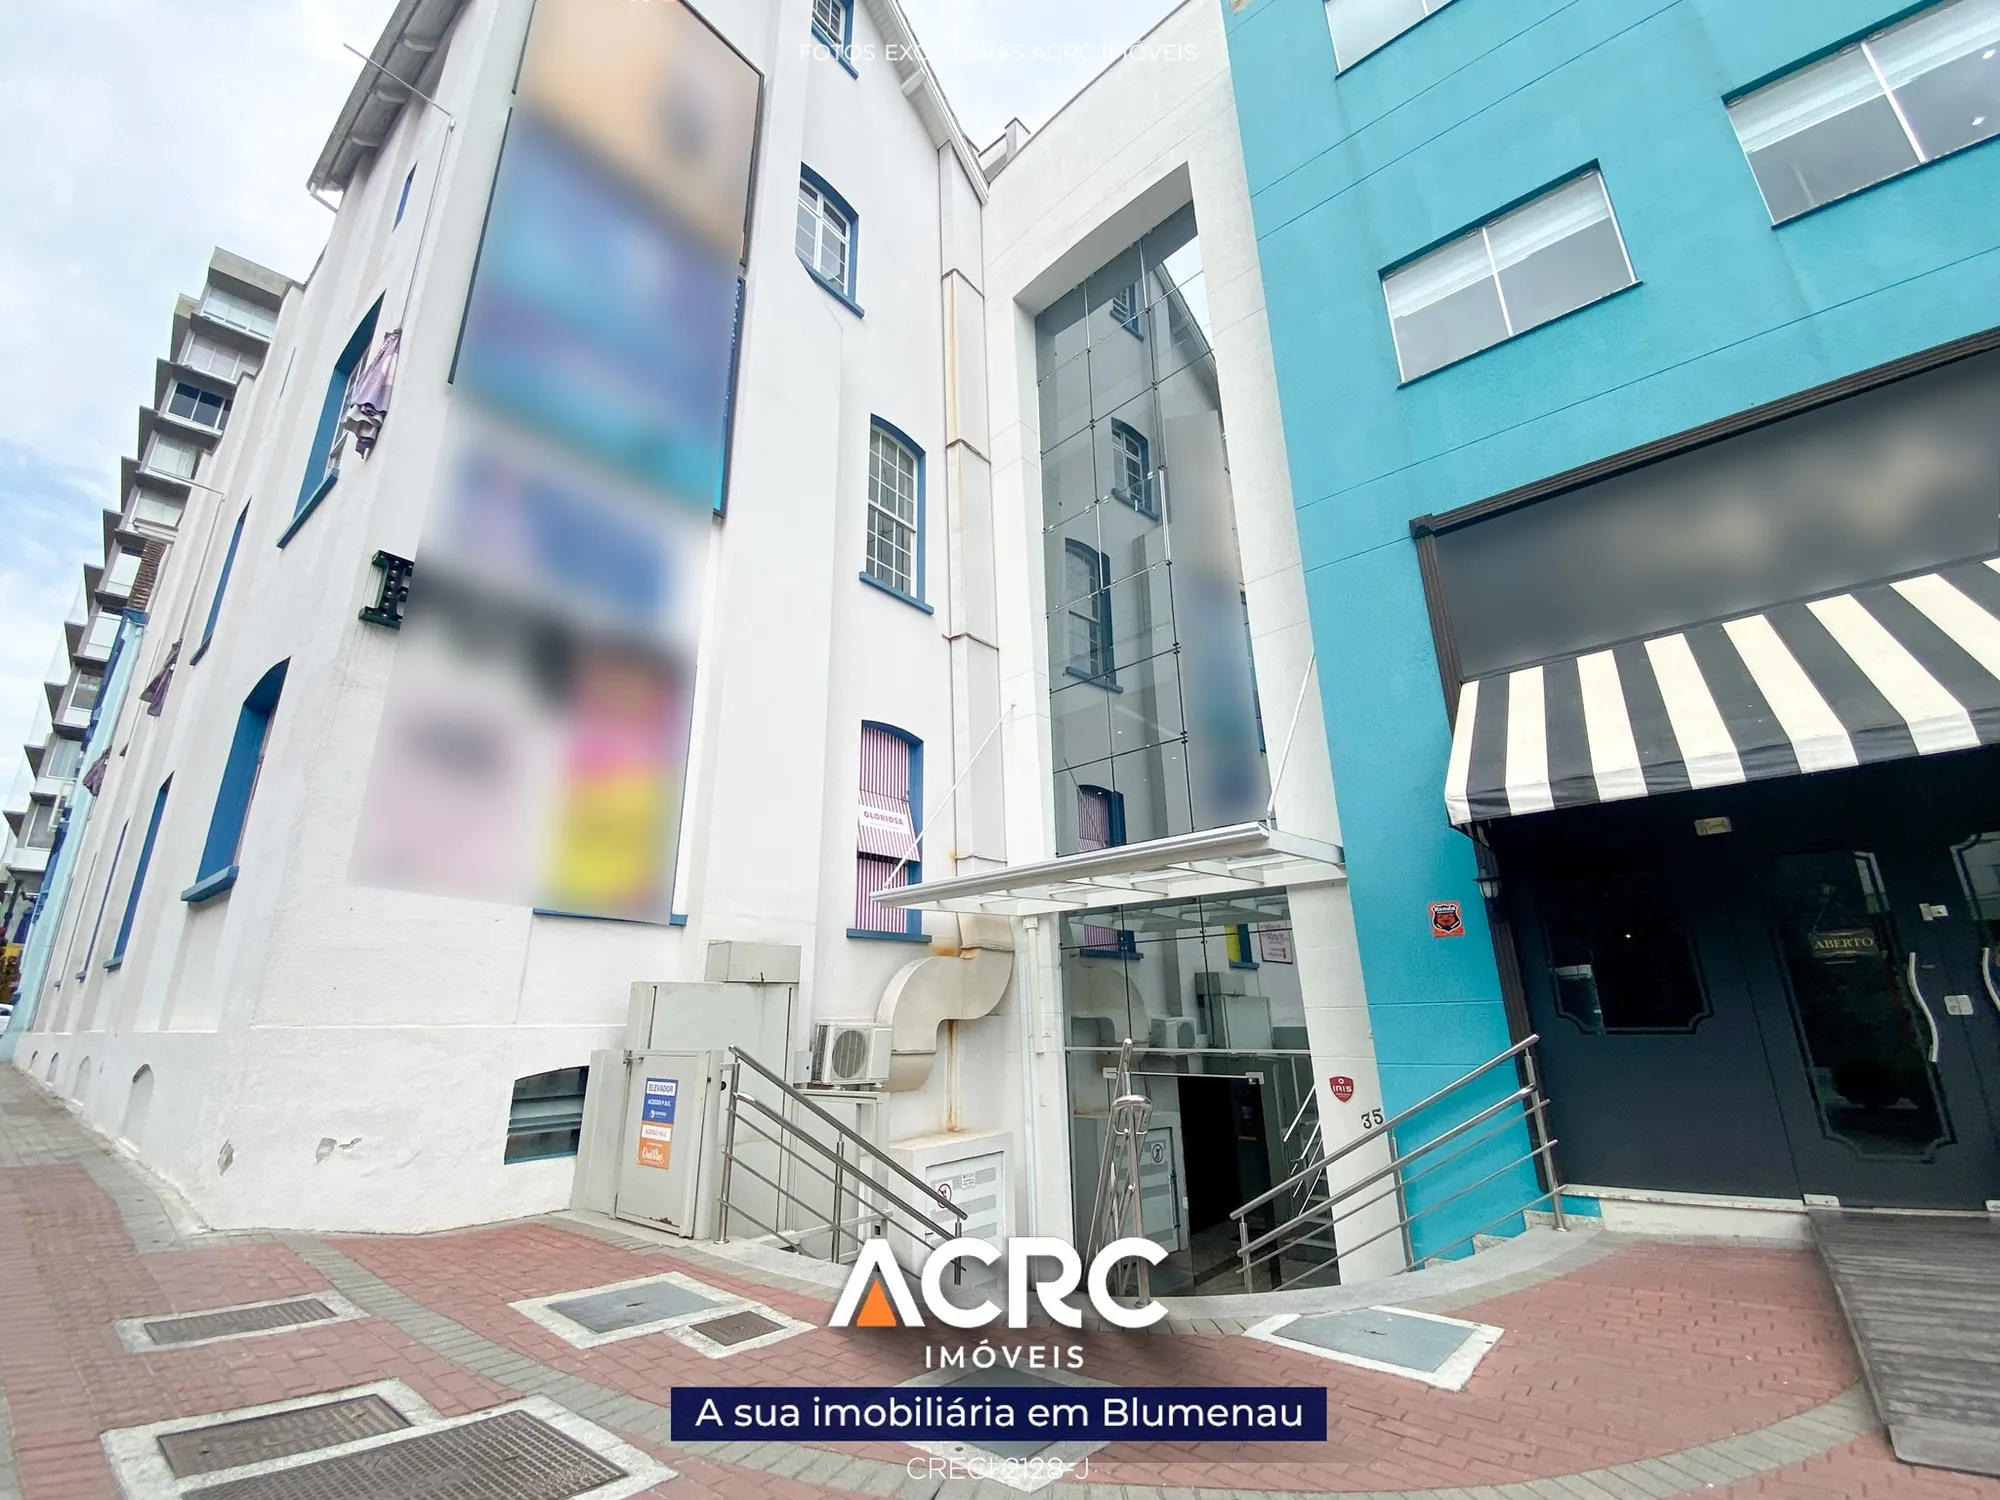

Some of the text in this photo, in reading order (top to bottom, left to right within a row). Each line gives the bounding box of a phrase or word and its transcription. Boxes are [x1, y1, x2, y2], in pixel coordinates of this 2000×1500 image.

[863, 811, 904, 825] GLORIOSA
[1814, 937, 1874, 949] ABERTO
[648, 1083, 674, 1093] ELEVADOR
[1332, 1085, 1353, 1093] IRIS
[1361, 1107, 1384, 1129] 35
